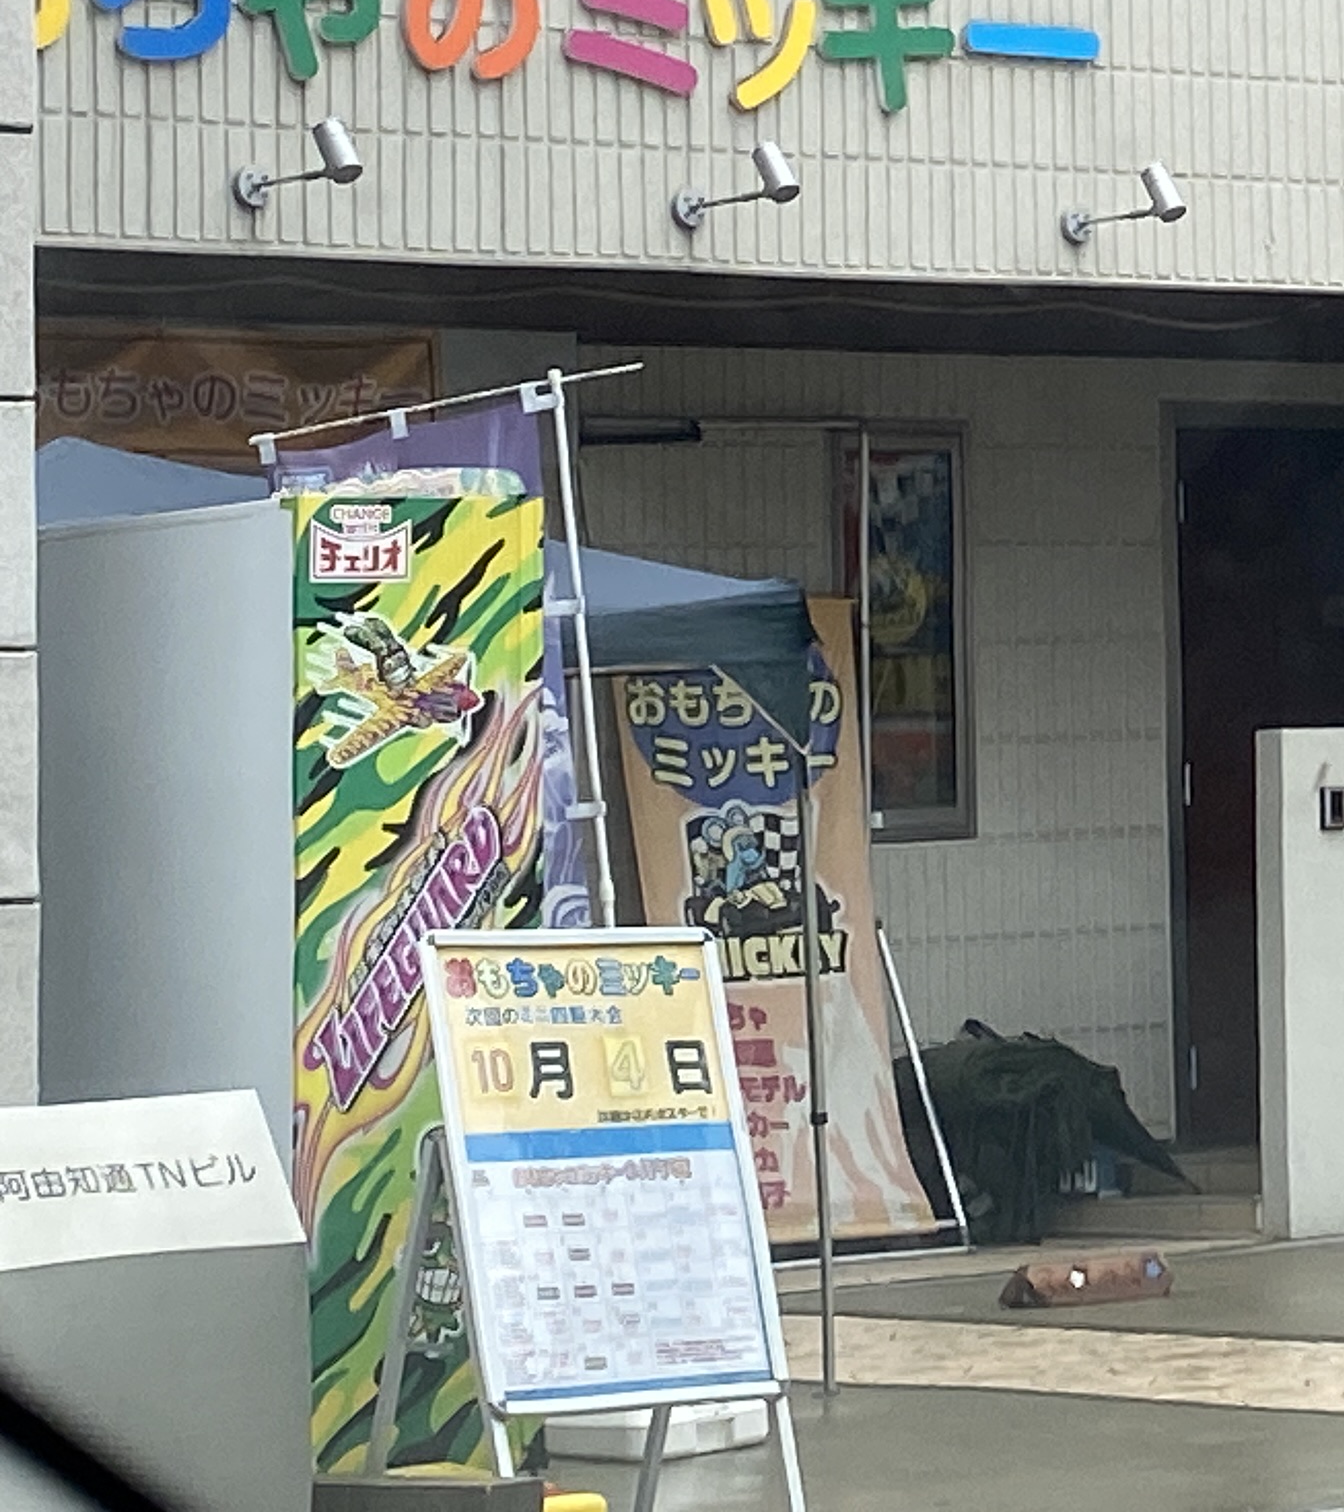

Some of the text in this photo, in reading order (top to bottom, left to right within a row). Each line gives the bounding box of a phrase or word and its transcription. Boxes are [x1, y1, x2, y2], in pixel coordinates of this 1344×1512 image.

[36, 368, 426, 426] もちゃのミッキー
[319, 537, 402, 573] チェリオ
[625, 680, 842, 727] おもちの
[652, 736, 836, 788] ミッキー
[444, 954, 702, 1000] おもちゃのミッキー
[717, 931, 846, 978] ICKY
